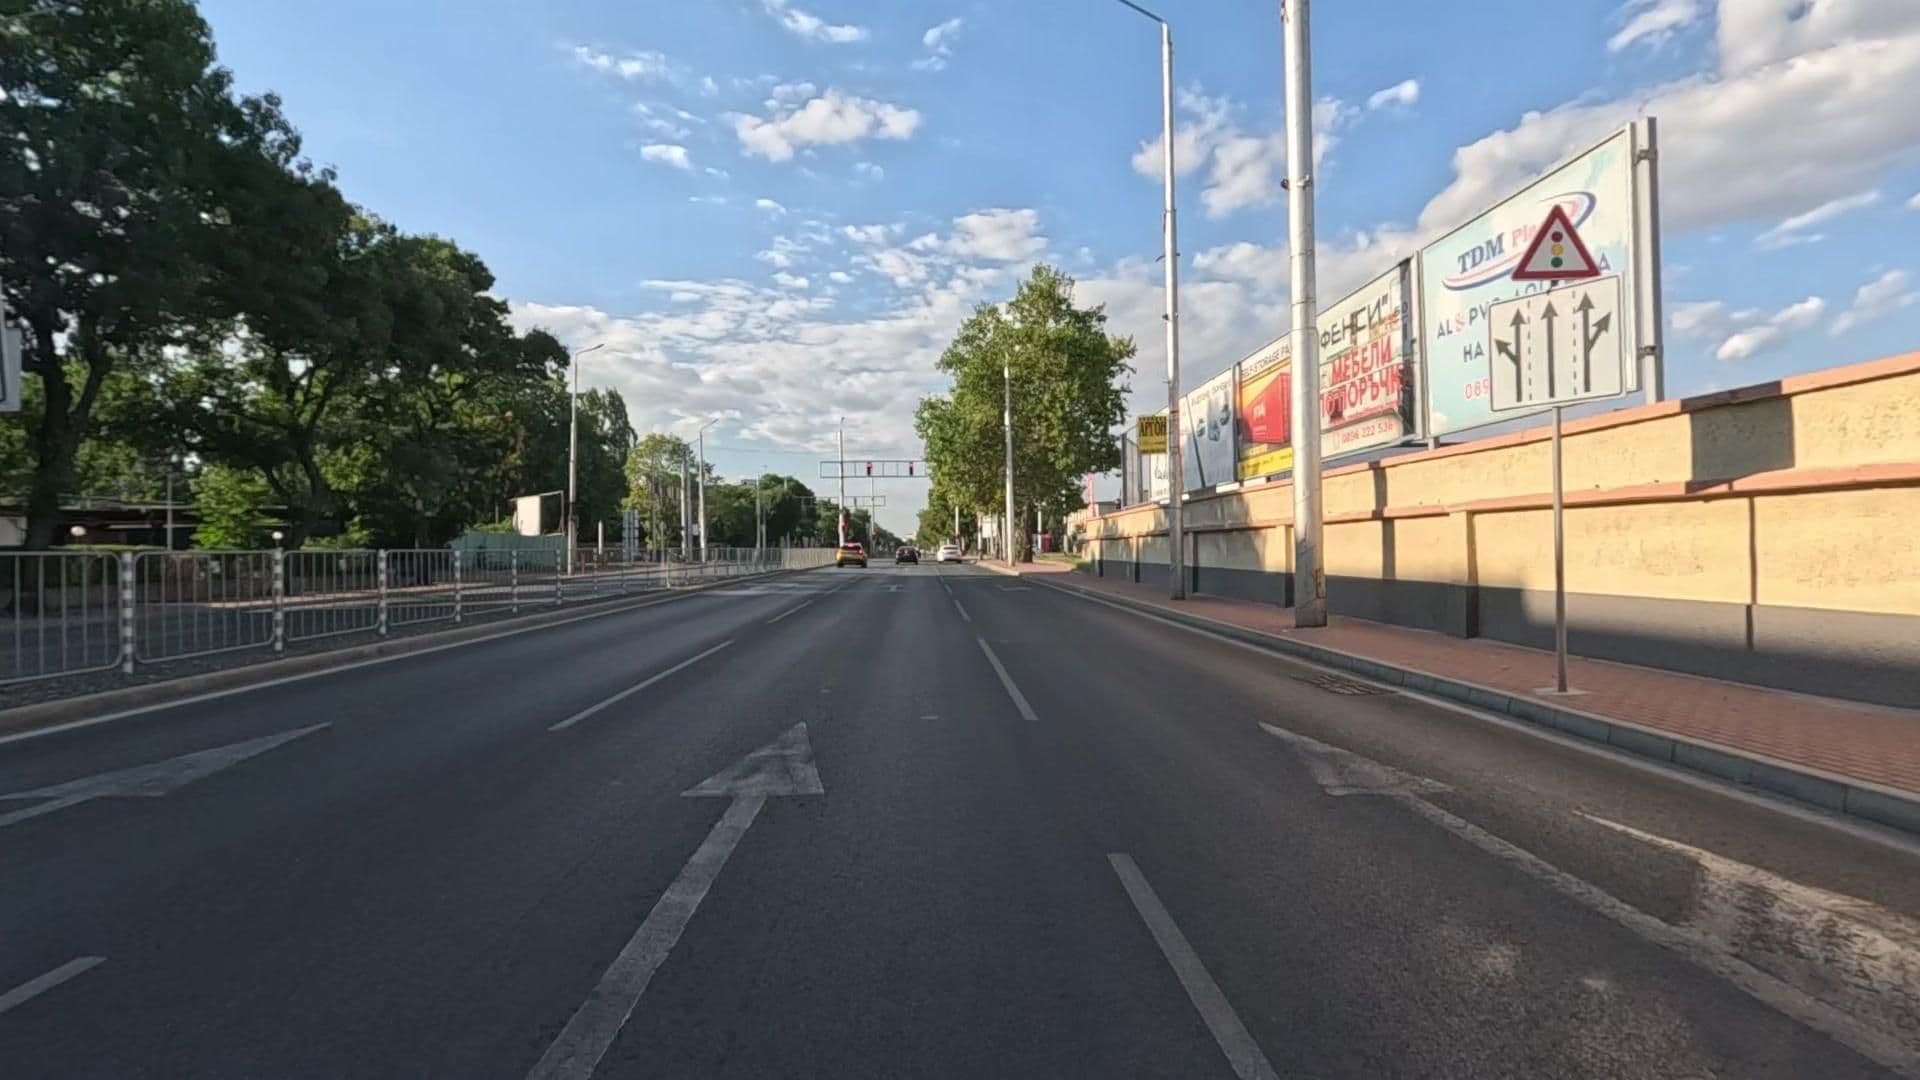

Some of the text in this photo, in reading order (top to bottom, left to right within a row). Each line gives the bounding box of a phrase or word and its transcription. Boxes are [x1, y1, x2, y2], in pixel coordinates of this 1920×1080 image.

[1457, 232, 1505, 274] TDM
[1331, 336, 1392, 385] МЕБЕЛИ
[1140, 421, 1167, 436] АРГОН
